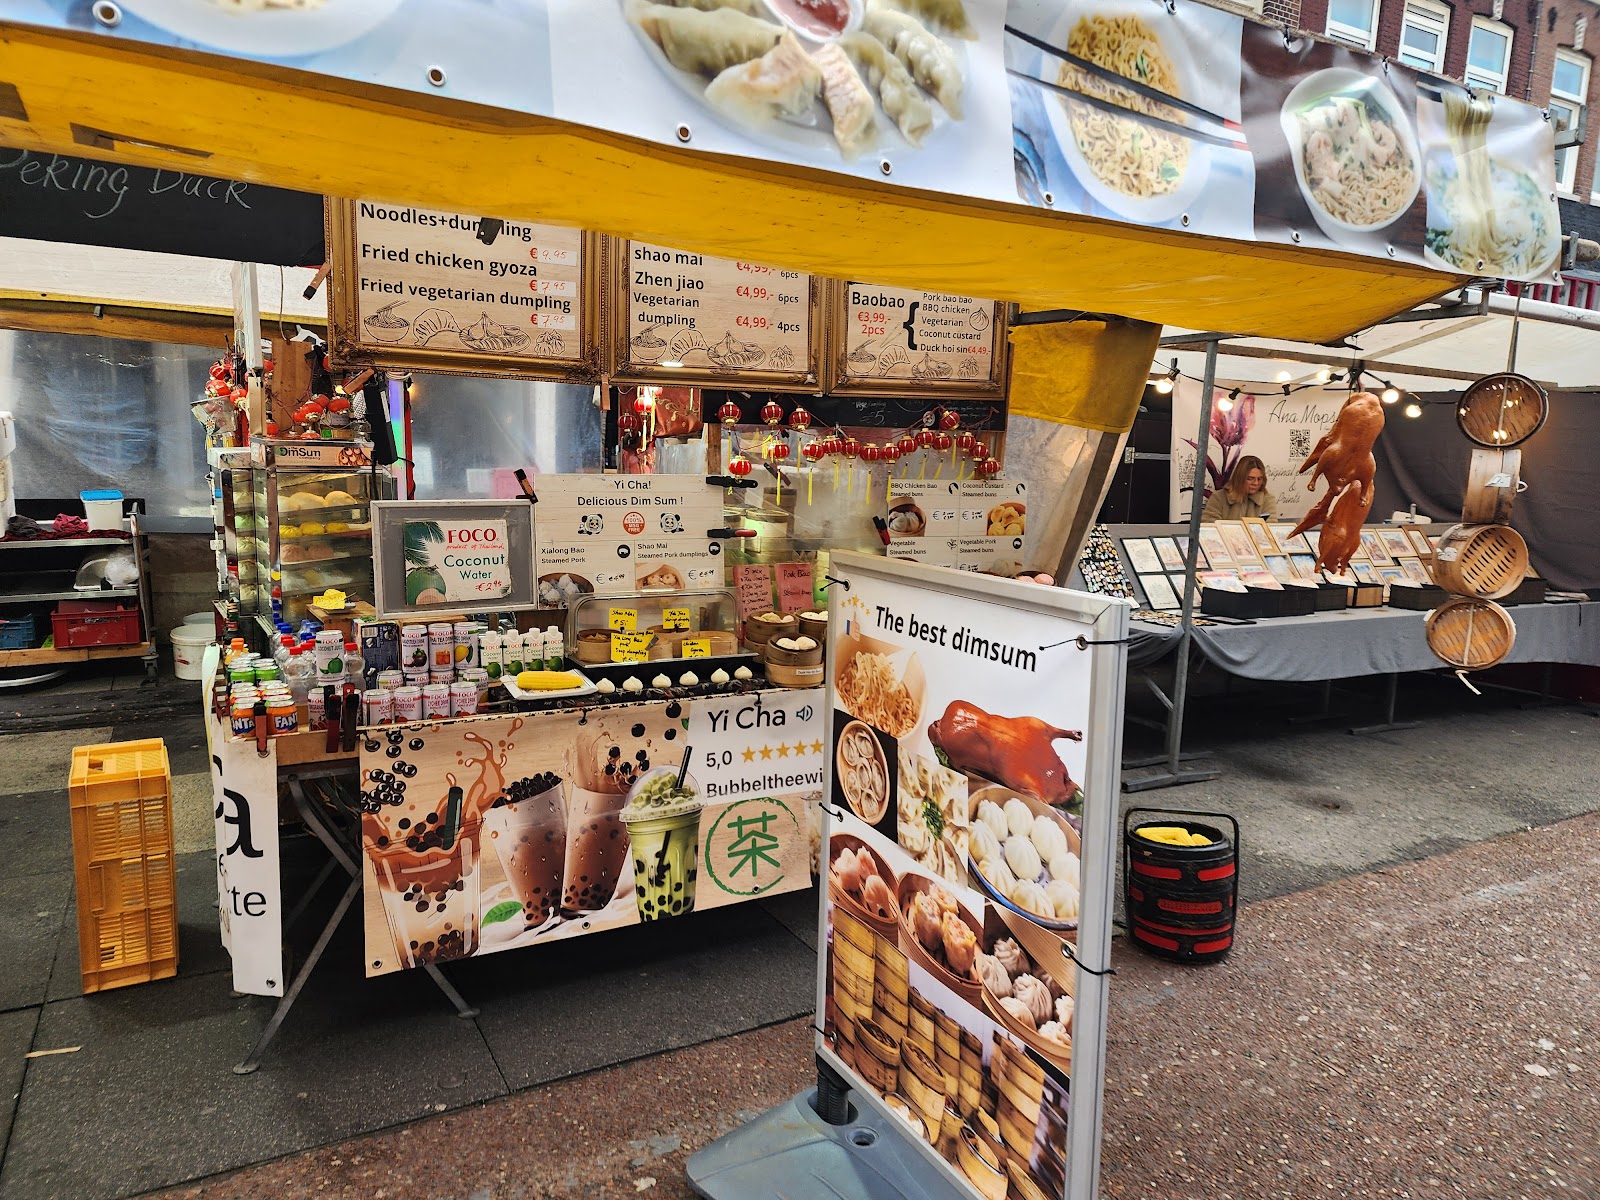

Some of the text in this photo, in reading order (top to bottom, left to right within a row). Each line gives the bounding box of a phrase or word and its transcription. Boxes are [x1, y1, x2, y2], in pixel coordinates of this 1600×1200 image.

[148, 168, 251, 209] Duck
[360, 202, 532, 242] Noodles+duling
[362, 243, 537, 276] Fried chicken gyoza
[635, 246, 703, 266] shao mai
[635, 271, 704, 292] Zhen jiao
[361, 277, 571, 313] Fried vegetarian dumpling
[633, 291, 700, 308] Vegetarian
[778, 293, 799, 304] 6pcs
[852, 291, 905, 309] Baobao
[923, 292, 973, 304] Pork bao bao
[922, 303, 970, 315] BBQ chicken
[638, 311, 696, 329] dumpling
[777, 321, 801, 334] 4pcs
[921, 316, 964, 327] Vegetarian
[861, 324, 885, 337] 2pcs
[919, 329, 981, 341] Coconut custard
[920, 343, 941, 352] Duck
[1269, 399, 1298, 424] Ana
[614, 480, 652, 490] Yi Cha!
[577, 496, 628, 506] Delicious
[631, 496, 651, 506] Dim
[654, 496, 678, 506] Sum
[448, 528, 497, 544] FOCO
[443, 553, 505, 568] Coconut
[459, 570, 492, 580] Water
[876, 605, 1036, 673] The best dimsum
[707, 704, 786, 733] Yi Cha
[706, 750, 733, 770] 5,0
[727, 811, 781, 878] 茶
